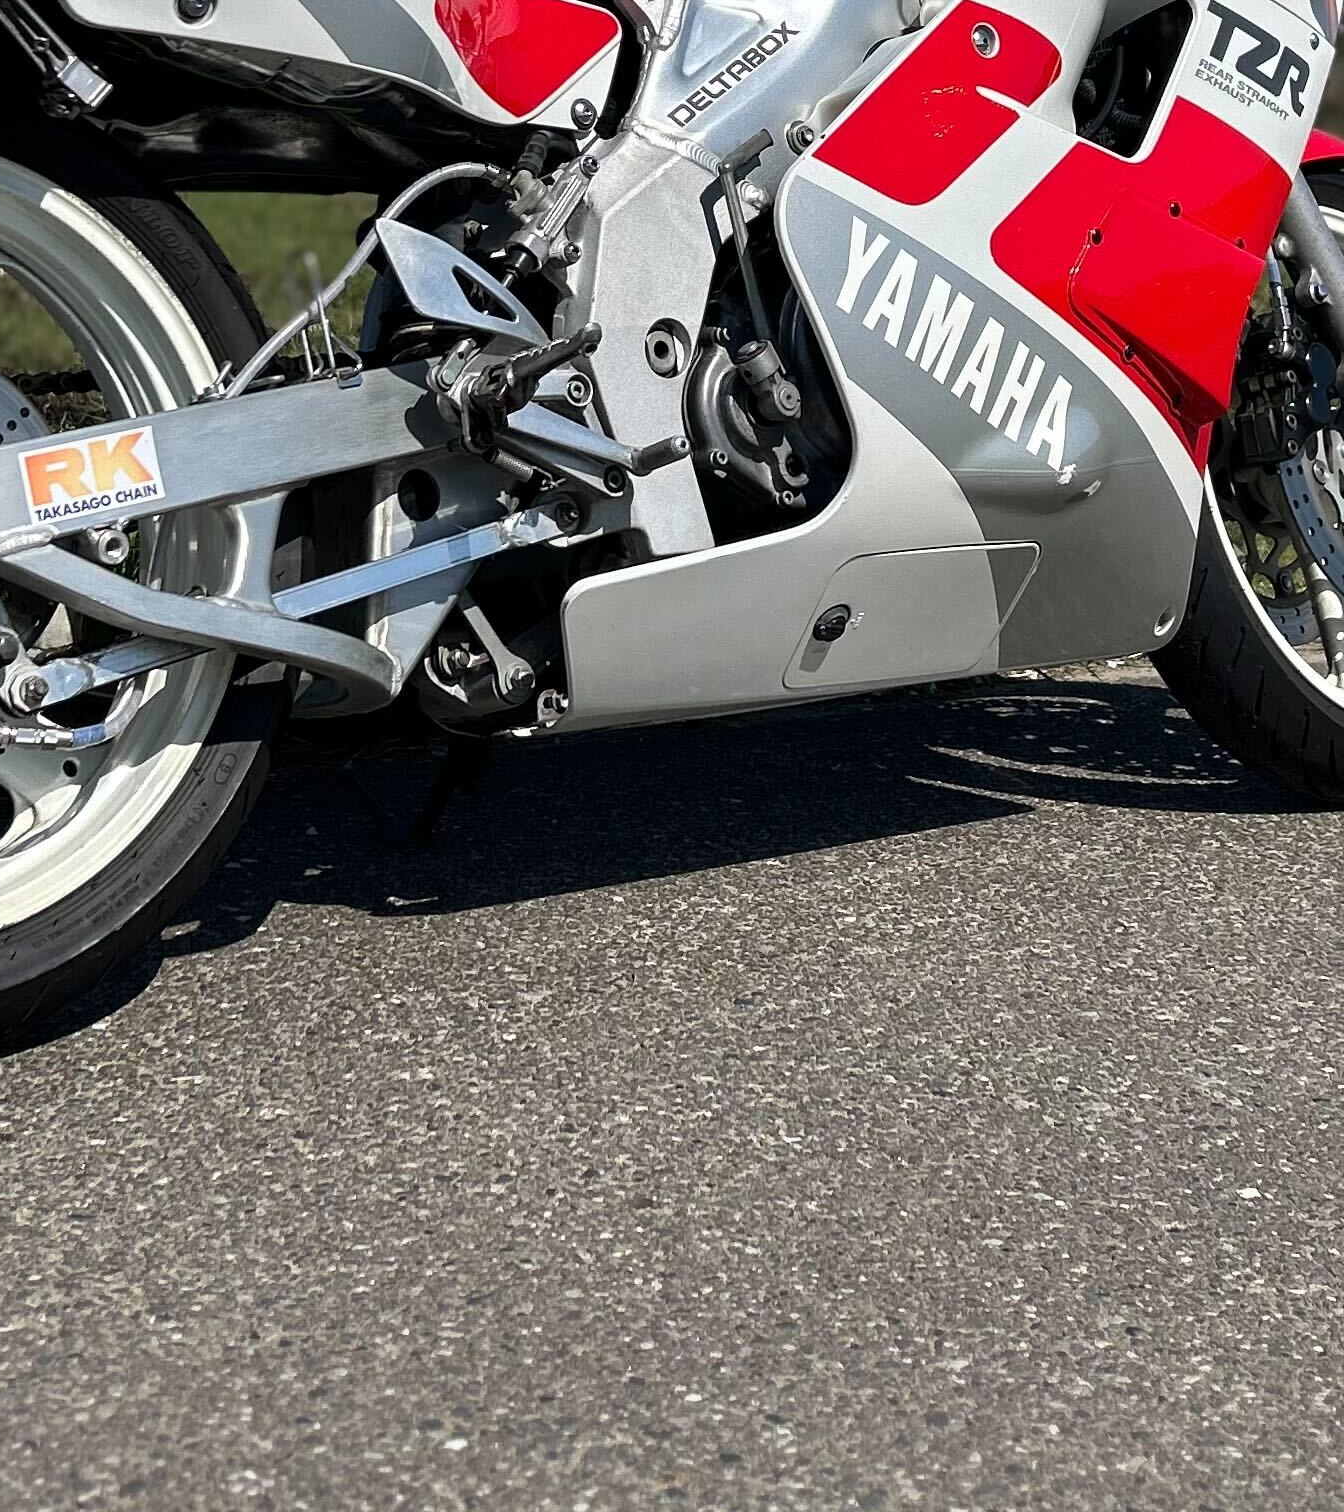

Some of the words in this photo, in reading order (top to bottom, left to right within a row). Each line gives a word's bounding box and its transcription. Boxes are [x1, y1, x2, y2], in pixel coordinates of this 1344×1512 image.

[667, 20, 801, 127] DELTABOX
[1195, 68, 1255, 107] EXHAUST
[1199, 59, 1234, 83] REAR
[1236, 80, 1290, 121] STRAIGHT
[835, 216, 1073, 471] YAMAHA
[24, 432, 154, 506] RK
[35, 495, 111, 521] TAKASAGO
[115, 484, 158, 504] CHAIN
